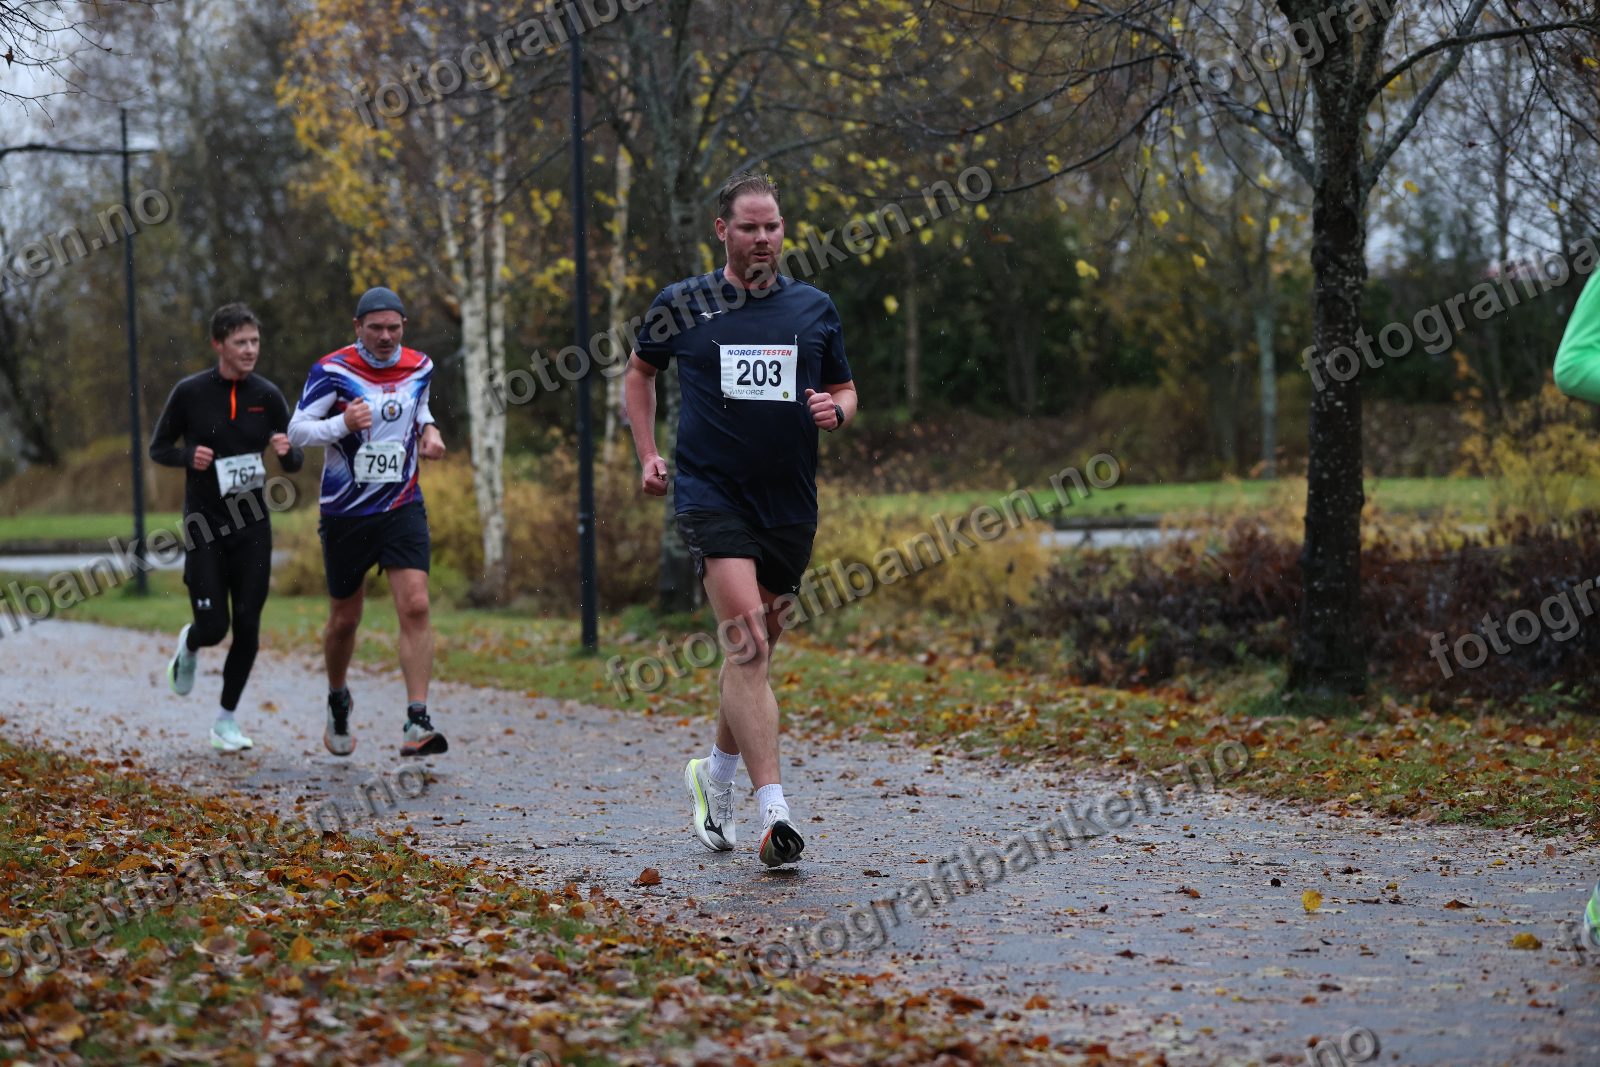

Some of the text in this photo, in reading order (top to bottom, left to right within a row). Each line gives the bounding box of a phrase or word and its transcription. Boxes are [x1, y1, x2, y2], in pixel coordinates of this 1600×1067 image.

[736, 359, 782, 387] 203
[365, 454, 398, 474] 794
[228, 466, 256, 488] 767
